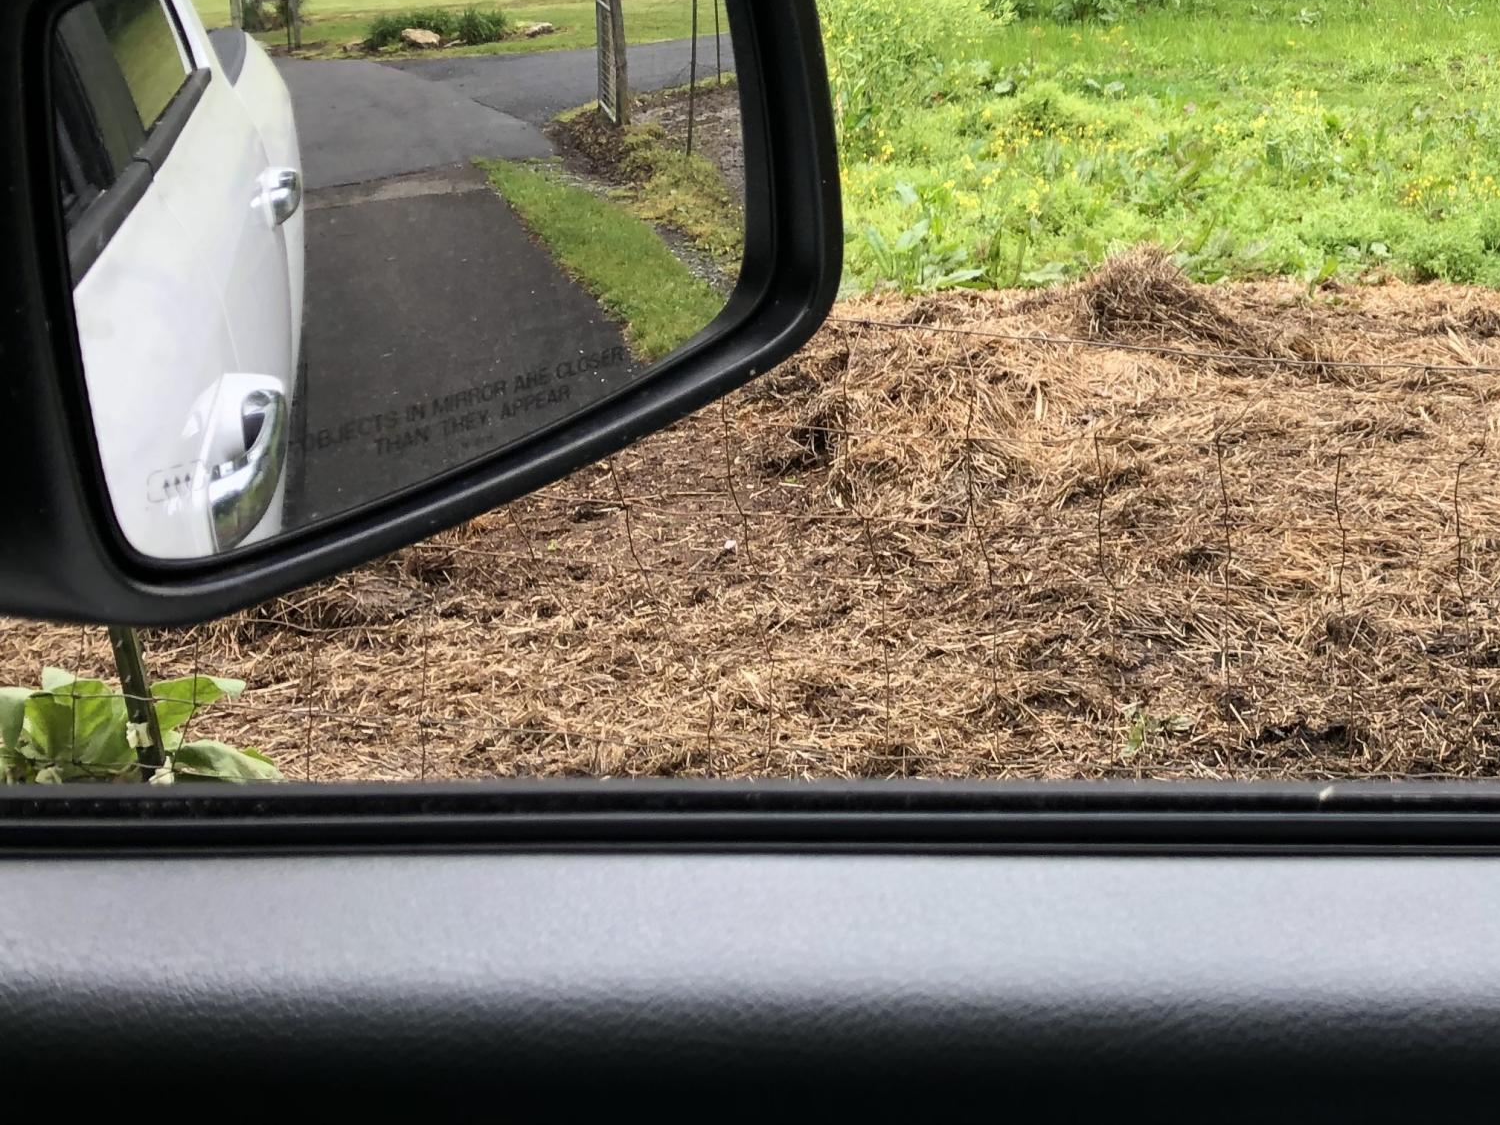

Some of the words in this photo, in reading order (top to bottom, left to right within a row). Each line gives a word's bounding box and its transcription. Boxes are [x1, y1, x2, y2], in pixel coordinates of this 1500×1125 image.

[305, 410, 398, 452] OBJECTS
[406, 403, 426, 423] IN
[432, 379, 507, 415] MIRROR
[513, 368, 549, 394] ARE
[555, 345, 624, 379] CLOSER
[375, 427, 430, 455] THAN
[441, 409, 489, 437] THEY
[500, 385, 571, 420] APPEAR
